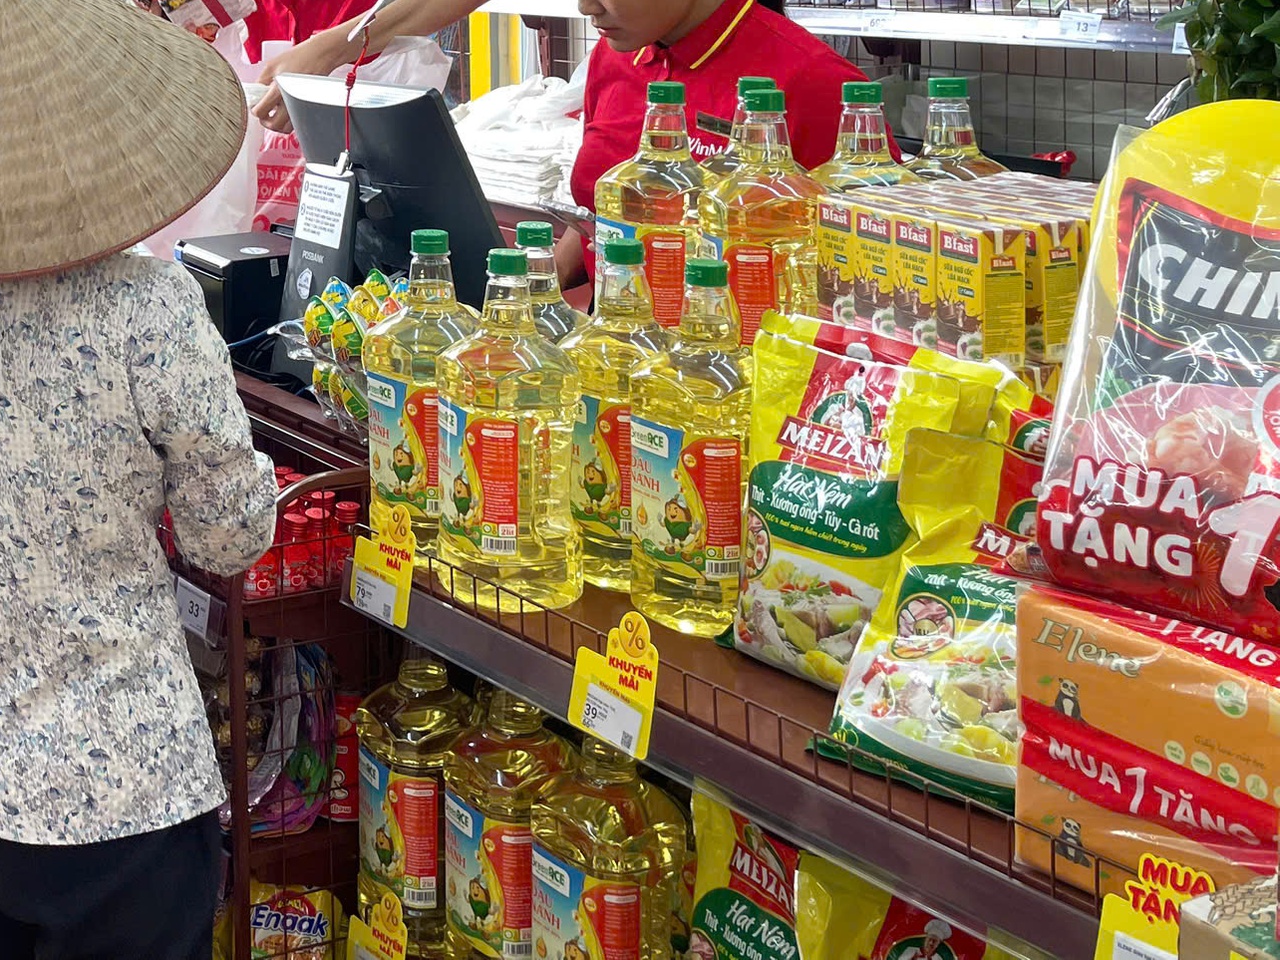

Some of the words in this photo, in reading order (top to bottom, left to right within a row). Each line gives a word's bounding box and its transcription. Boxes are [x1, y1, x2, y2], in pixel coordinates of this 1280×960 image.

[1076, 21, 1089, 33] 13
[780, 420, 883, 467] MEIZAN
[773, 470, 813, 498] Hạt
[809, 477, 852, 510] Nêm
[1072, 456, 1199, 520] MUA
[751, 485, 765, 506] Thịt
[770, 493, 799, 518] Xương
[799, 503, 818, 524] ống
[824, 510, 842, 532] Tủy
[849, 518, 861, 536] Cà
[862, 522, 880, 541] rốt
[379, 542, 412, 563] KHUYẾN
[1042, 502, 1194, 577] TẶNG
[1208, 495, 1280, 597] 1
[188, 600, 200, 618] 33
[356, 585, 366, 599] 79
[608, 655, 652, 681] KHUYẾN
[584, 703, 597, 719] 39
[1048, 735, 1122, 794] MUA
[1125, 767, 1147, 815] 1
[731, 845, 795, 917] MEIZA
[1141, 857, 1210, 897] MUA
[251, 905, 329, 937] Enaak
[1128, 885, 1181, 927] TẶN
[372, 926, 404, 955] KHUYẾN
[704, 908, 719, 932] Thịt
[722, 923, 746, 957] Xương
[726, 899, 756, 933] Hạt
[752, 919, 797, 960] Nêm
